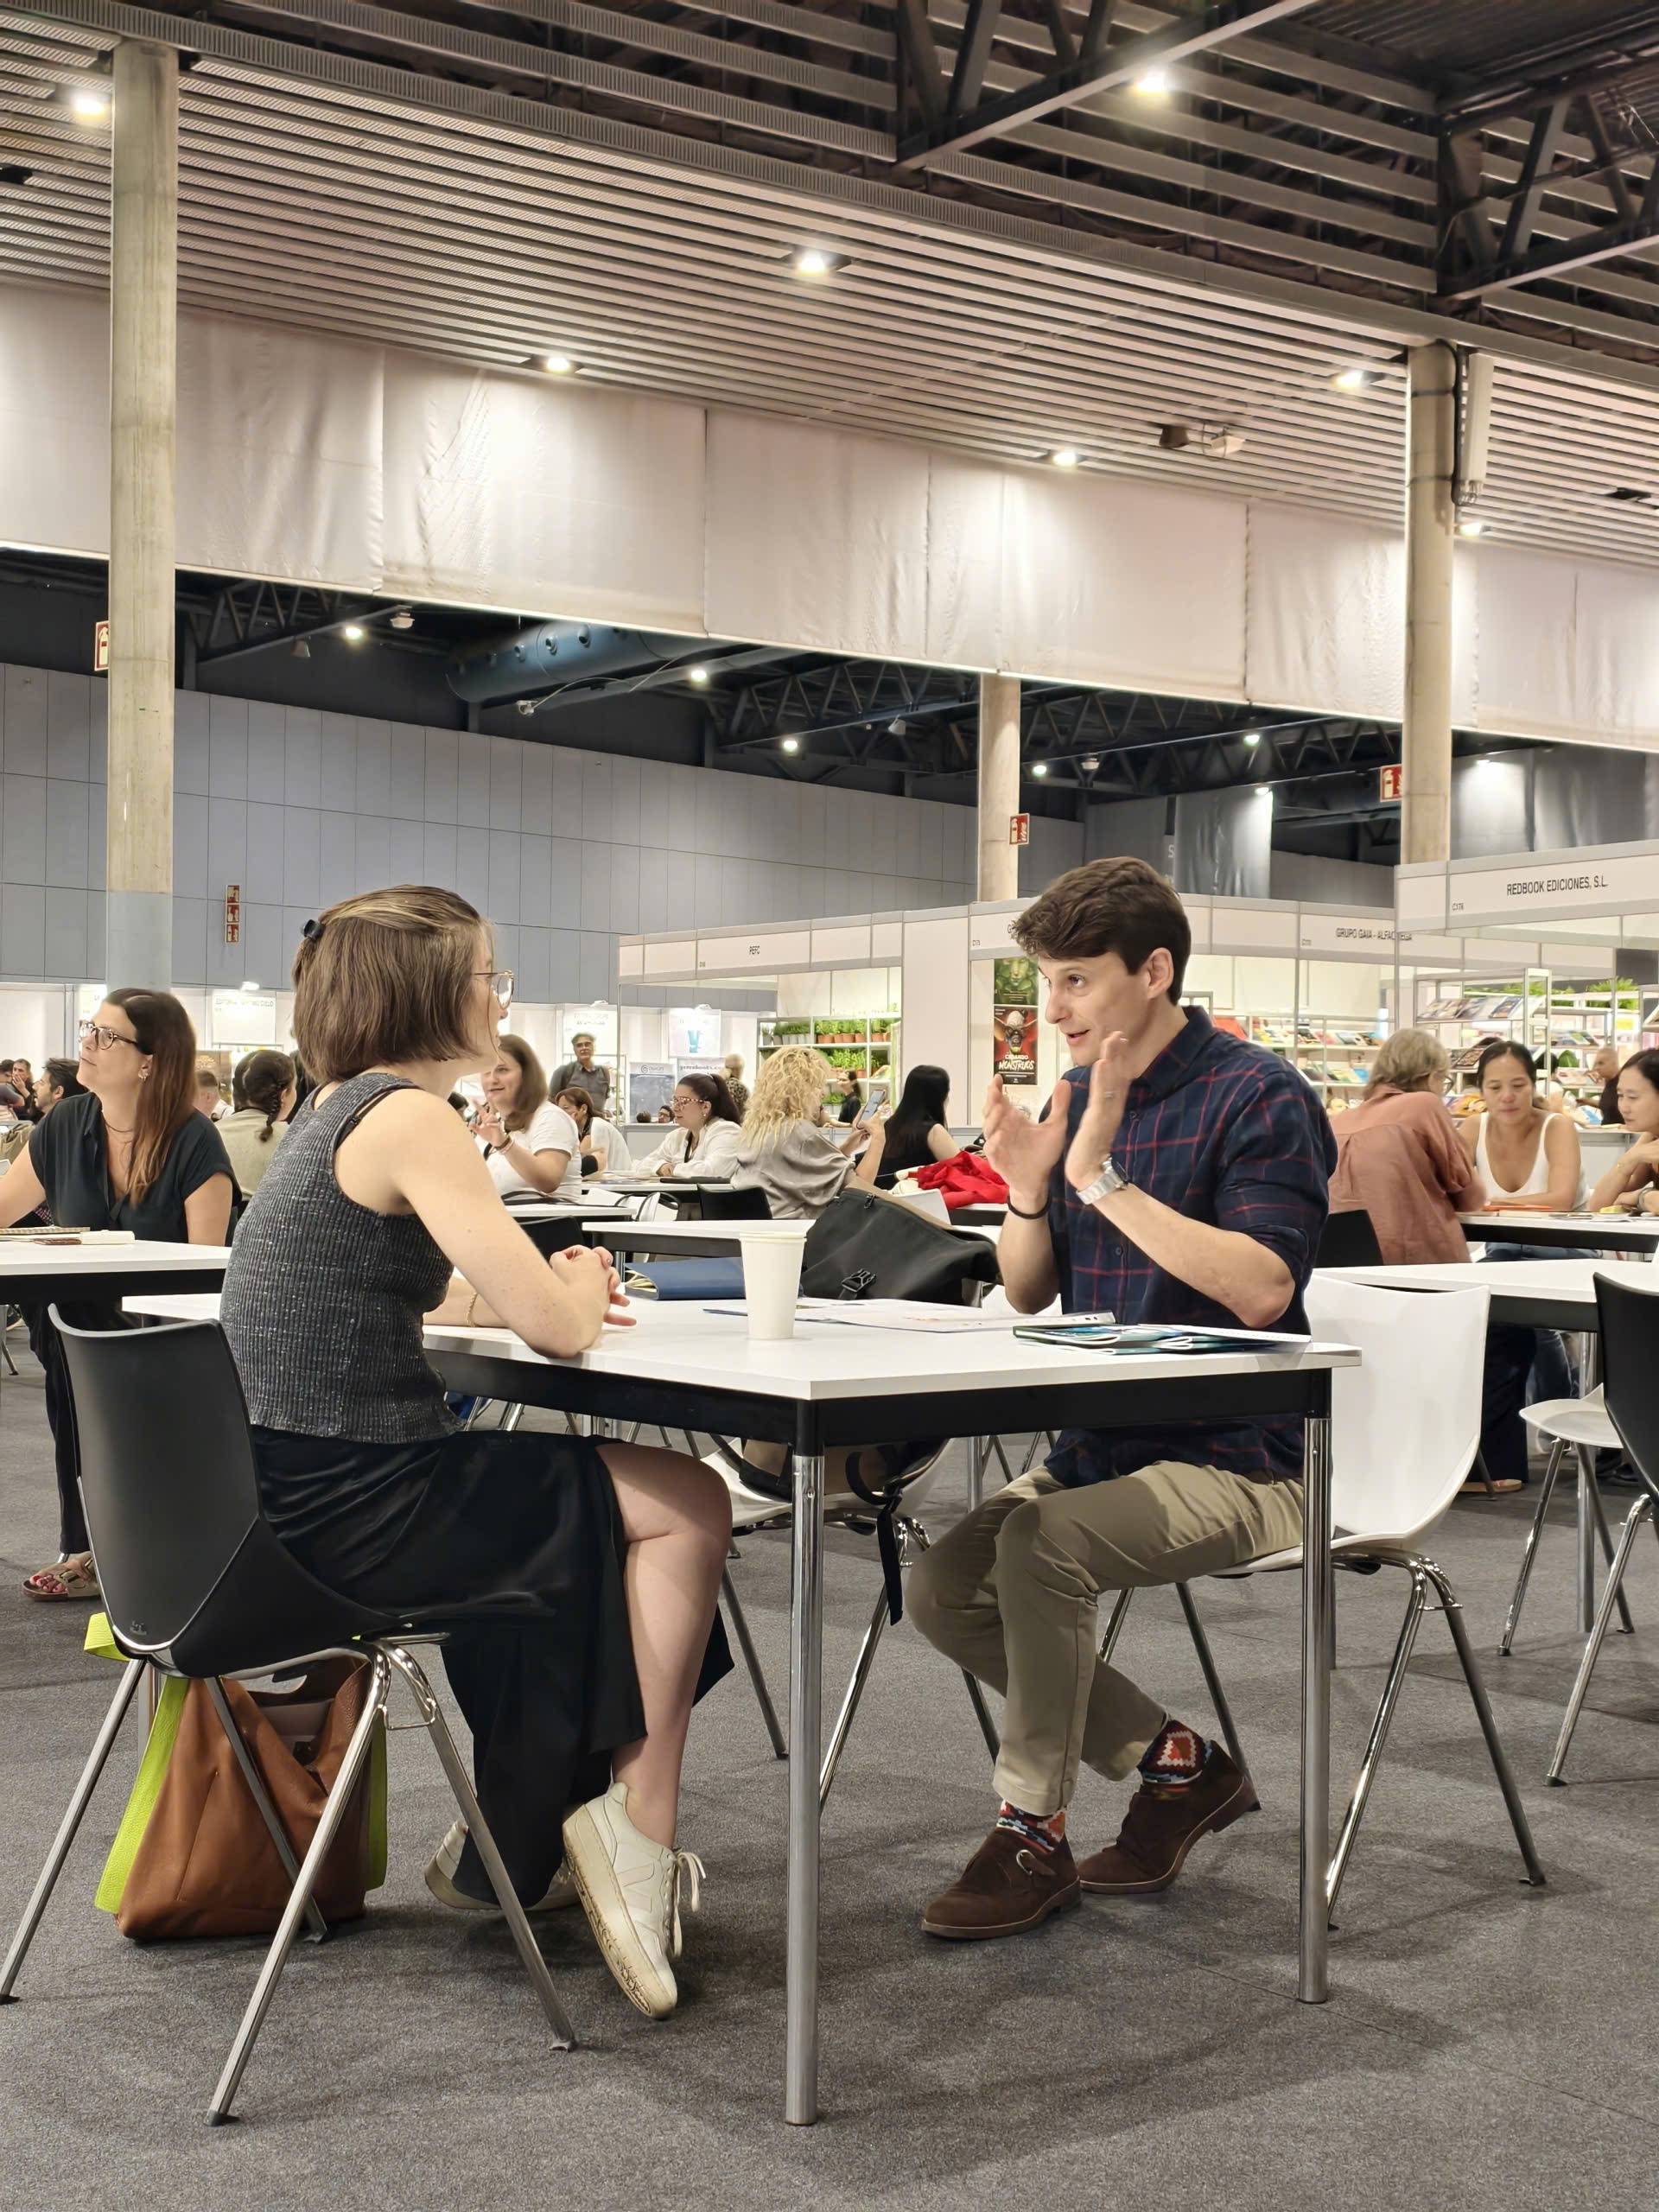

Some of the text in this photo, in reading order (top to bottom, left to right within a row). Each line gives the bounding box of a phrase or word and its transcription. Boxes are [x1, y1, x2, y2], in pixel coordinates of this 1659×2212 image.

[1507, 880, 1545, 896] REDBOOK
[1547, 876, 1592, 892] EDICIONES,
[1336, 927, 1357, 939] GRUPO
[998, 1059, 1035, 1072] MONSTRUOS
